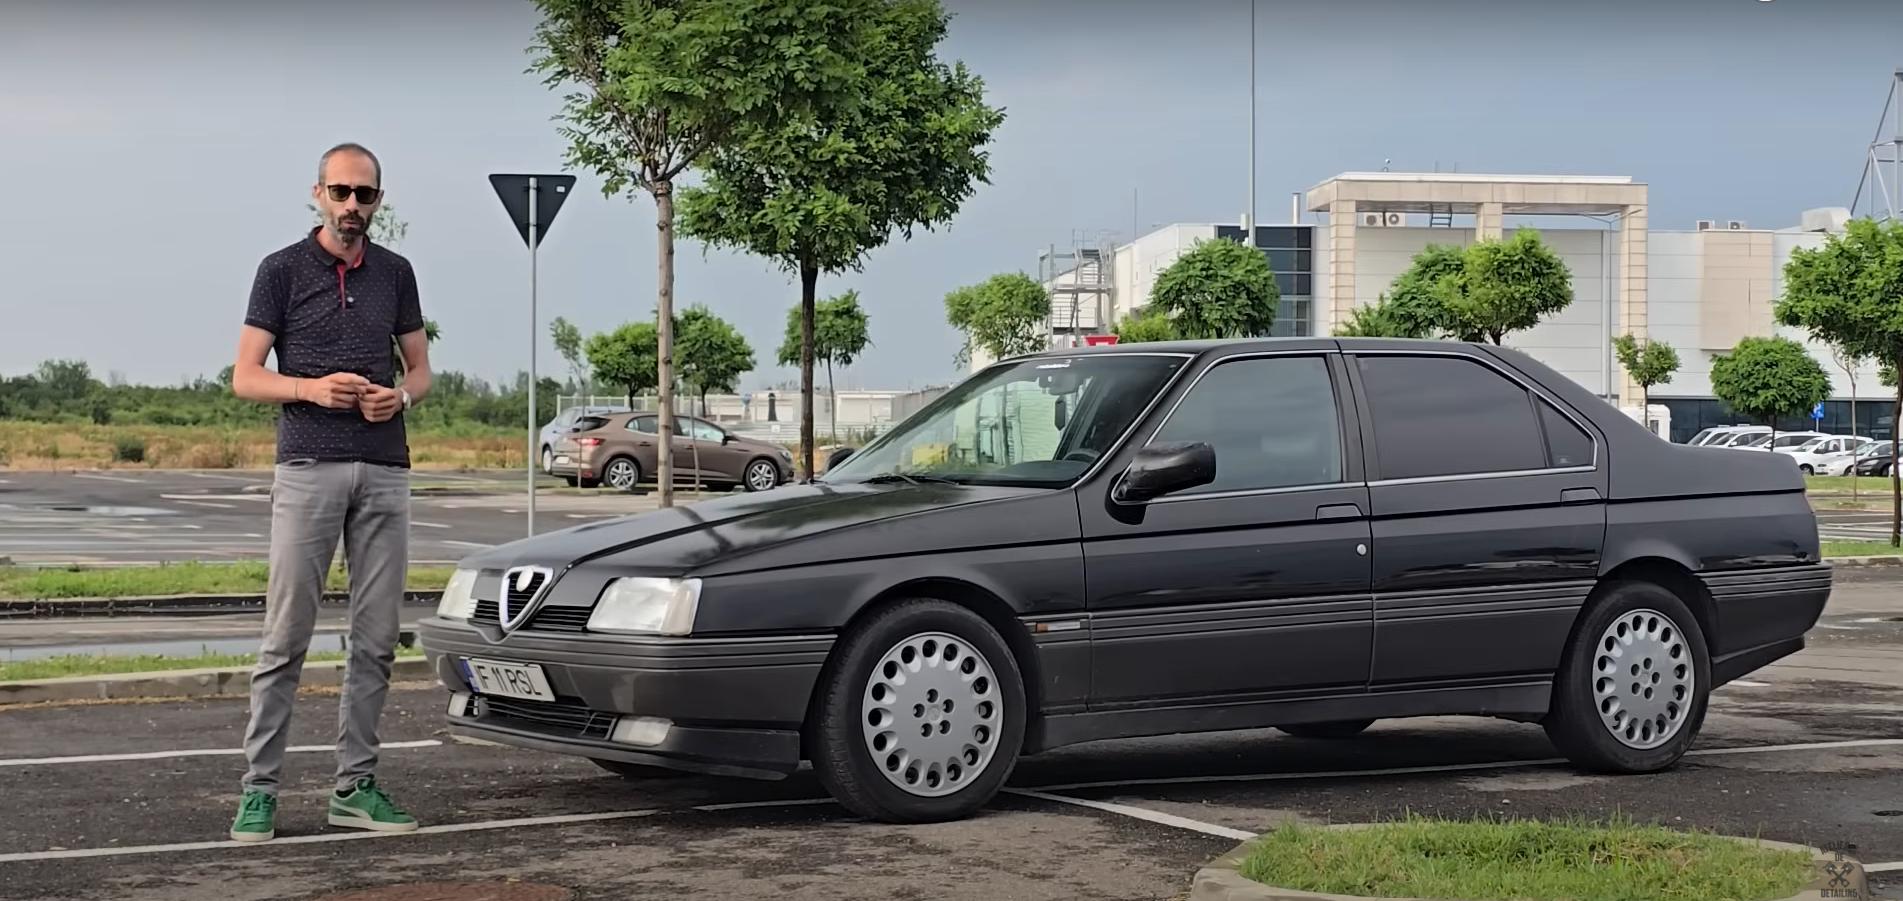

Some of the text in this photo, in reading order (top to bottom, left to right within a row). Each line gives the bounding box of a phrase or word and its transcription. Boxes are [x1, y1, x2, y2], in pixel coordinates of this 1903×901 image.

[473, 664, 543, 696] IF 11 RSL
